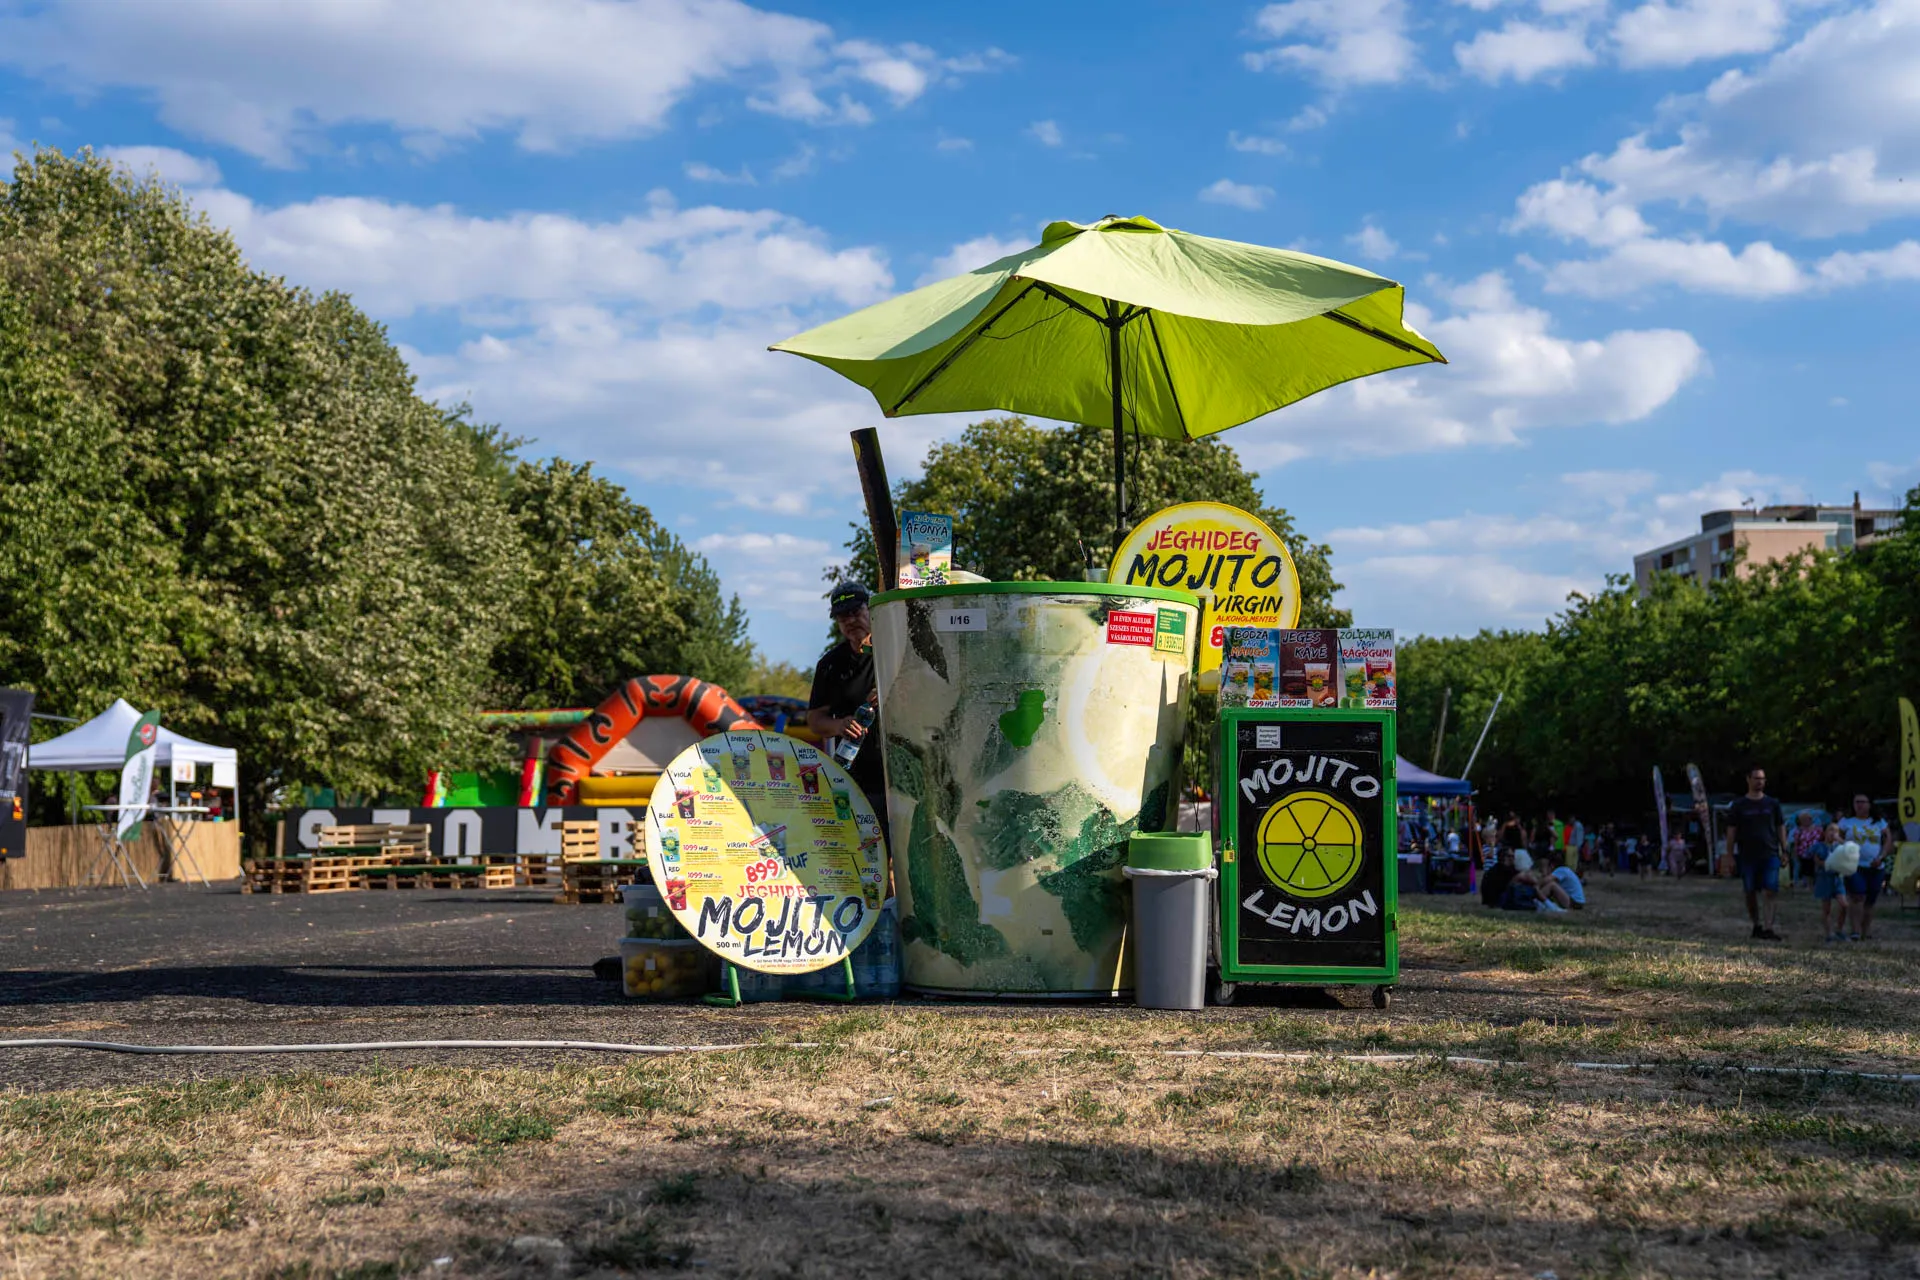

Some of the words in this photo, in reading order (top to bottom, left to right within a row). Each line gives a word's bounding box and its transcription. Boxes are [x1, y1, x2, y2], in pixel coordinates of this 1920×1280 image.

[1147, 524, 1262, 552] JÉGHIDEG
[1126, 554, 1282, 592] MOJITO
[1212, 594, 1284, 615] VIRGIN
[950, 616, 970, 625] I/16
[1119, 614, 1132, 623] ÉVEN
[1216, 615, 1278, 623] ALKOHOLMENTES
[1234, 630, 1268, 640] BODZA
[1282, 631, 1322, 644] JEGES
[1356, 640, 1377, 648] VAGY
[1294, 643, 1328, 660] KÁVÉ
[1239, 755, 1382, 804] MOJITO
[746, 859, 779, 883] 899
[783, 852, 808, 870] HUF
[736, 882, 818, 898] JÉGHIDEG
[698, 896, 864, 938] MOJITO
[1242, 889, 1378, 936] LEMON
[744, 930, 848, 958] LEMON
